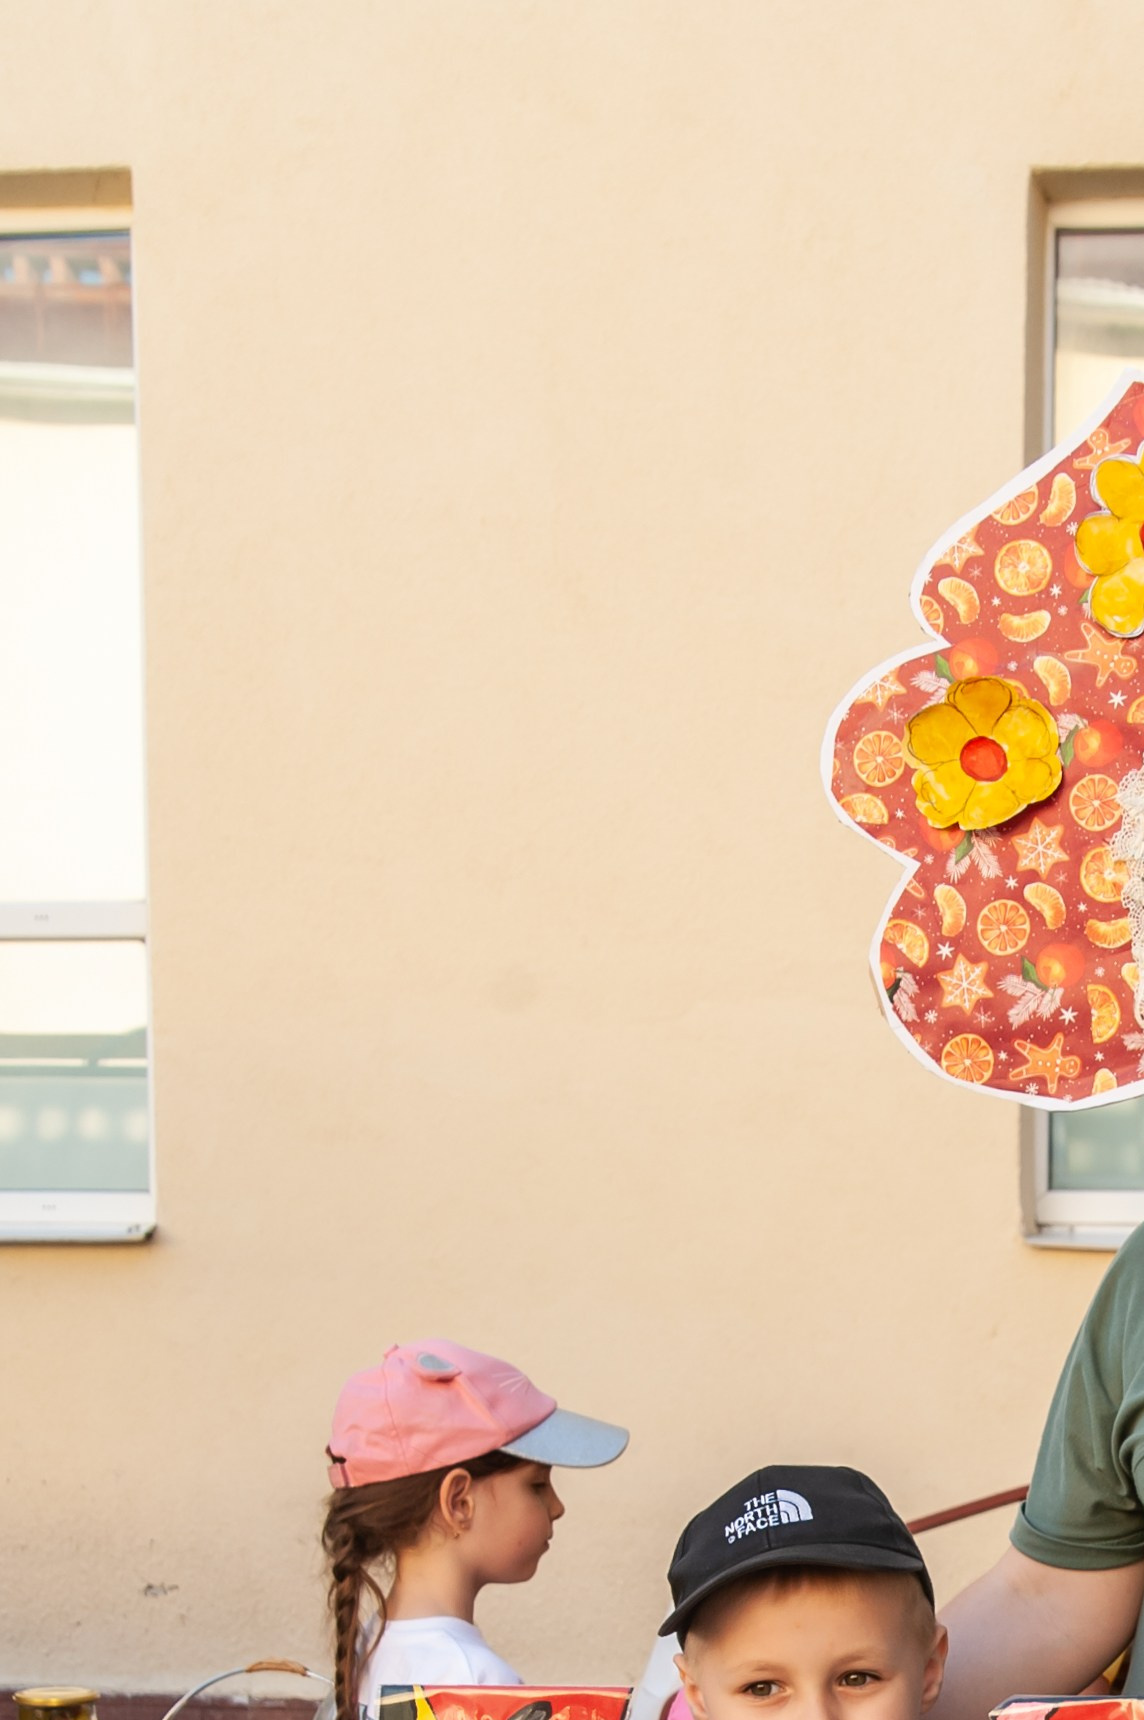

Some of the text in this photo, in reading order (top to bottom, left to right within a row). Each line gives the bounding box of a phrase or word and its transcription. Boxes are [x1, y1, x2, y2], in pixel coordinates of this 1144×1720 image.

[744, 1491, 777, 1511] THE
[725, 1503, 779, 1538] NORTH
[737, 1514, 780, 1539] FACE
